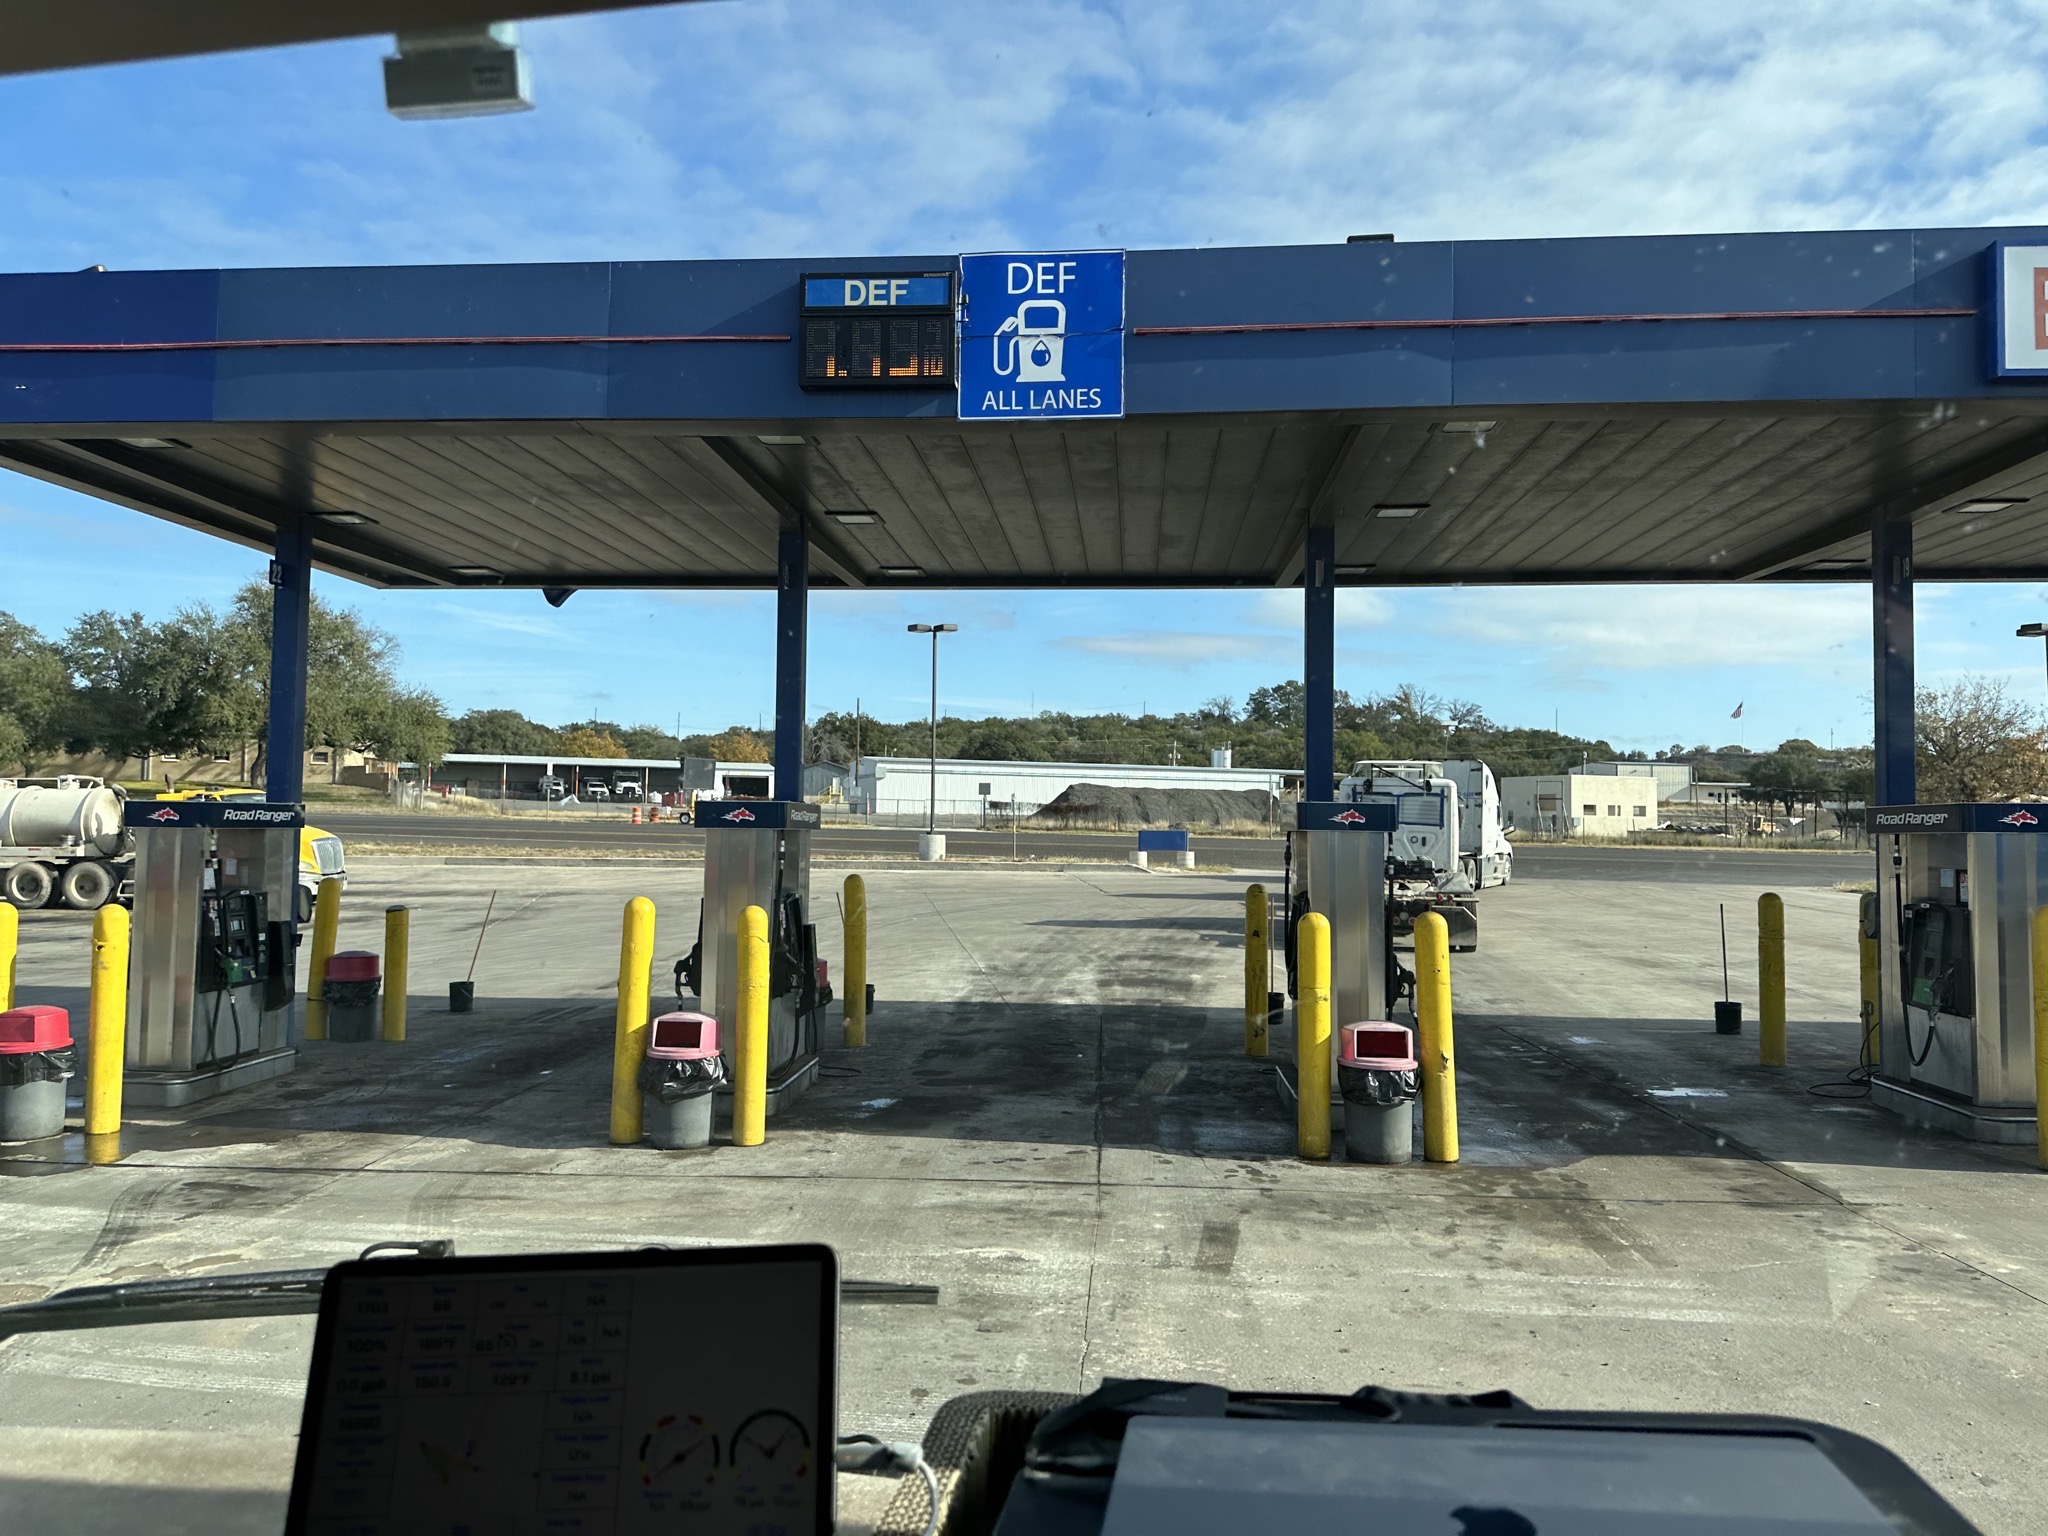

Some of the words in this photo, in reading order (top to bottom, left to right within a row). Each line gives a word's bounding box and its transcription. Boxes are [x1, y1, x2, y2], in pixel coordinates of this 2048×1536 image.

[1008, 262, 1077, 294] DEF
[844, 280, 909, 306] DEF
[982, 390, 1023, 411] ALL
[1030, 388, 1102, 410] LANES
[271, 564, 282, 584] 22
[224, 809, 255, 820] Road
[255, 810, 295, 822] Ranger
[1876, 813, 1905, 825] Road
[1905, 812, 1948, 826] Ranger
